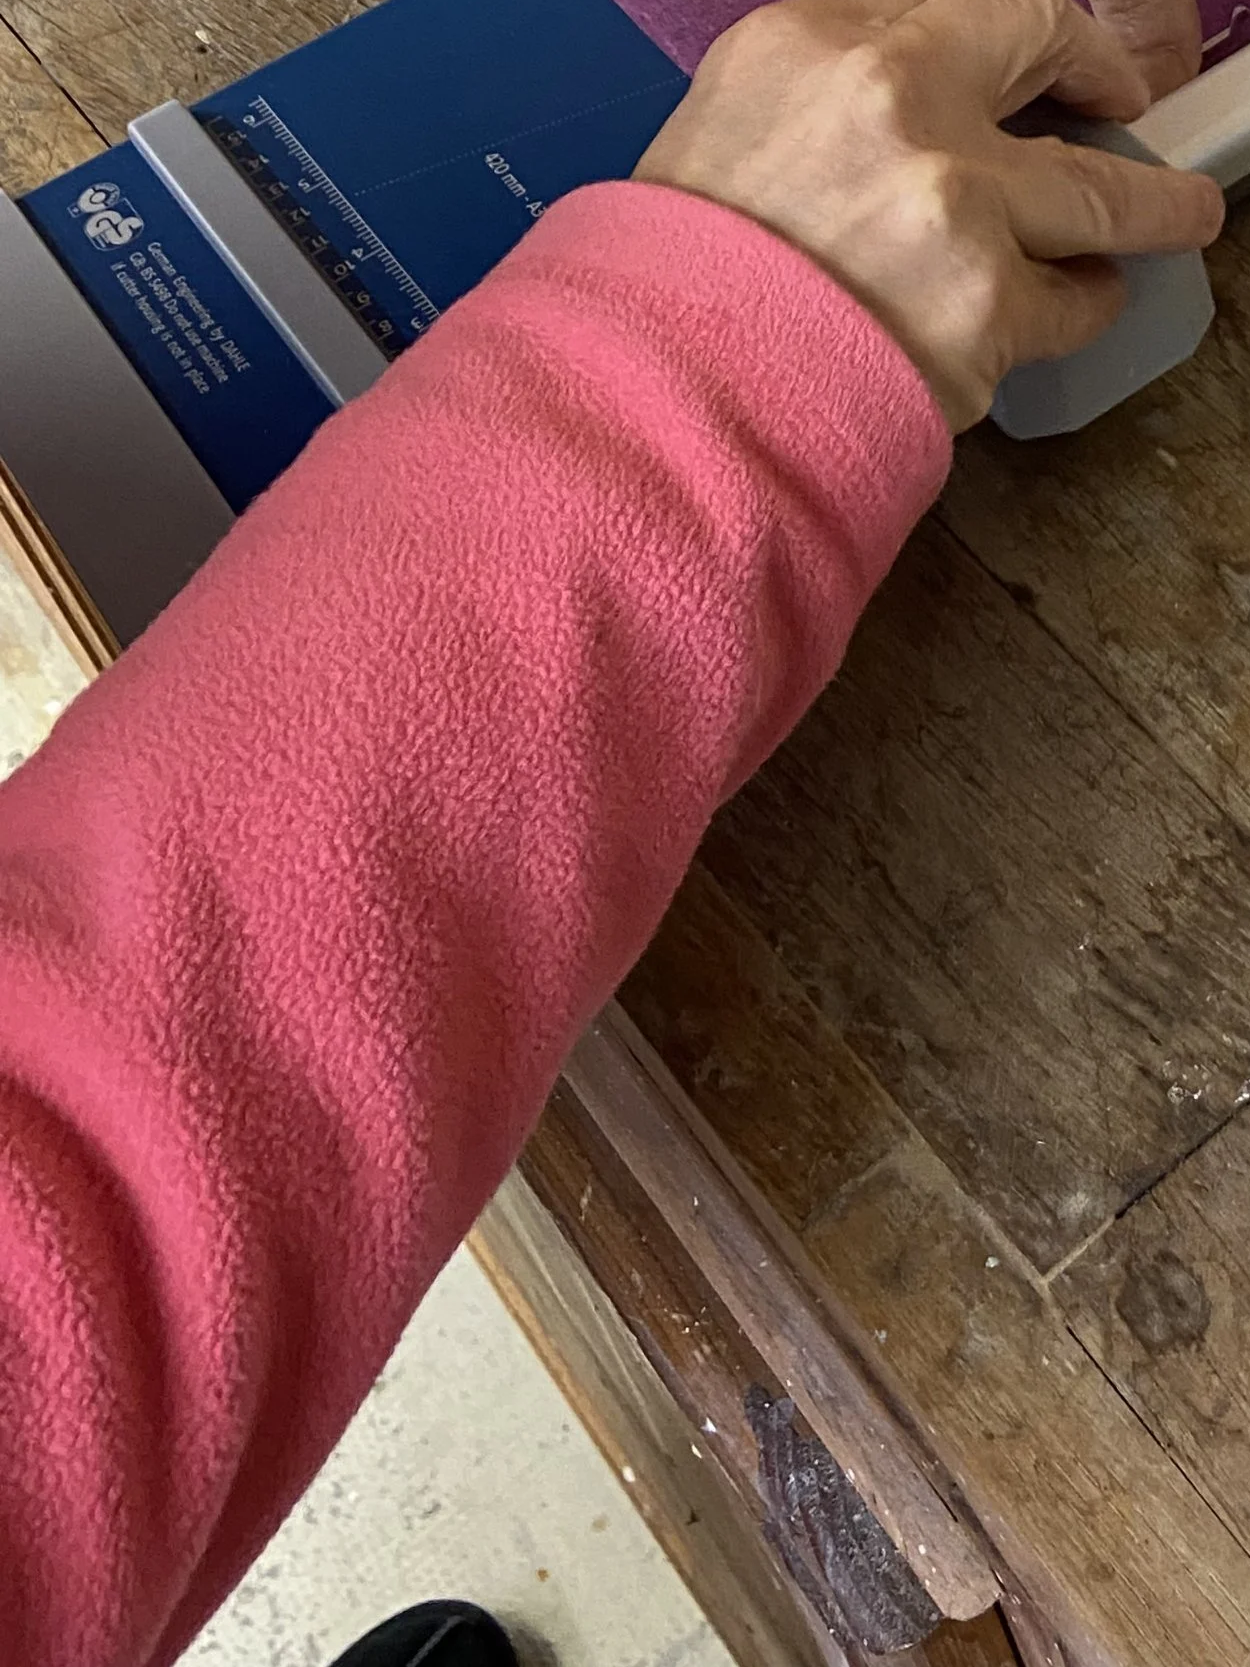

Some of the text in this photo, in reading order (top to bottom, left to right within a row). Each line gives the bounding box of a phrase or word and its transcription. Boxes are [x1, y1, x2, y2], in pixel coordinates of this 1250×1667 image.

[485, 152, 510, 175] 420
[501, 173, 526, 198] mm
[116, 270, 141, 298] cutter
[135, 294, 166, 335] housing
[147, 241, 251, 373] German Engineering by DAHLE
[160, 328, 173, 342] is
[163, 298, 179, 315] Do
[173, 311, 193, 332] not
[184, 328, 202, 347] use
[198, 342, 229, 384] machine
[166, 338, 186, 359] not
[176, 354, 193, 370] in
[184, 366, 210, 394] place
